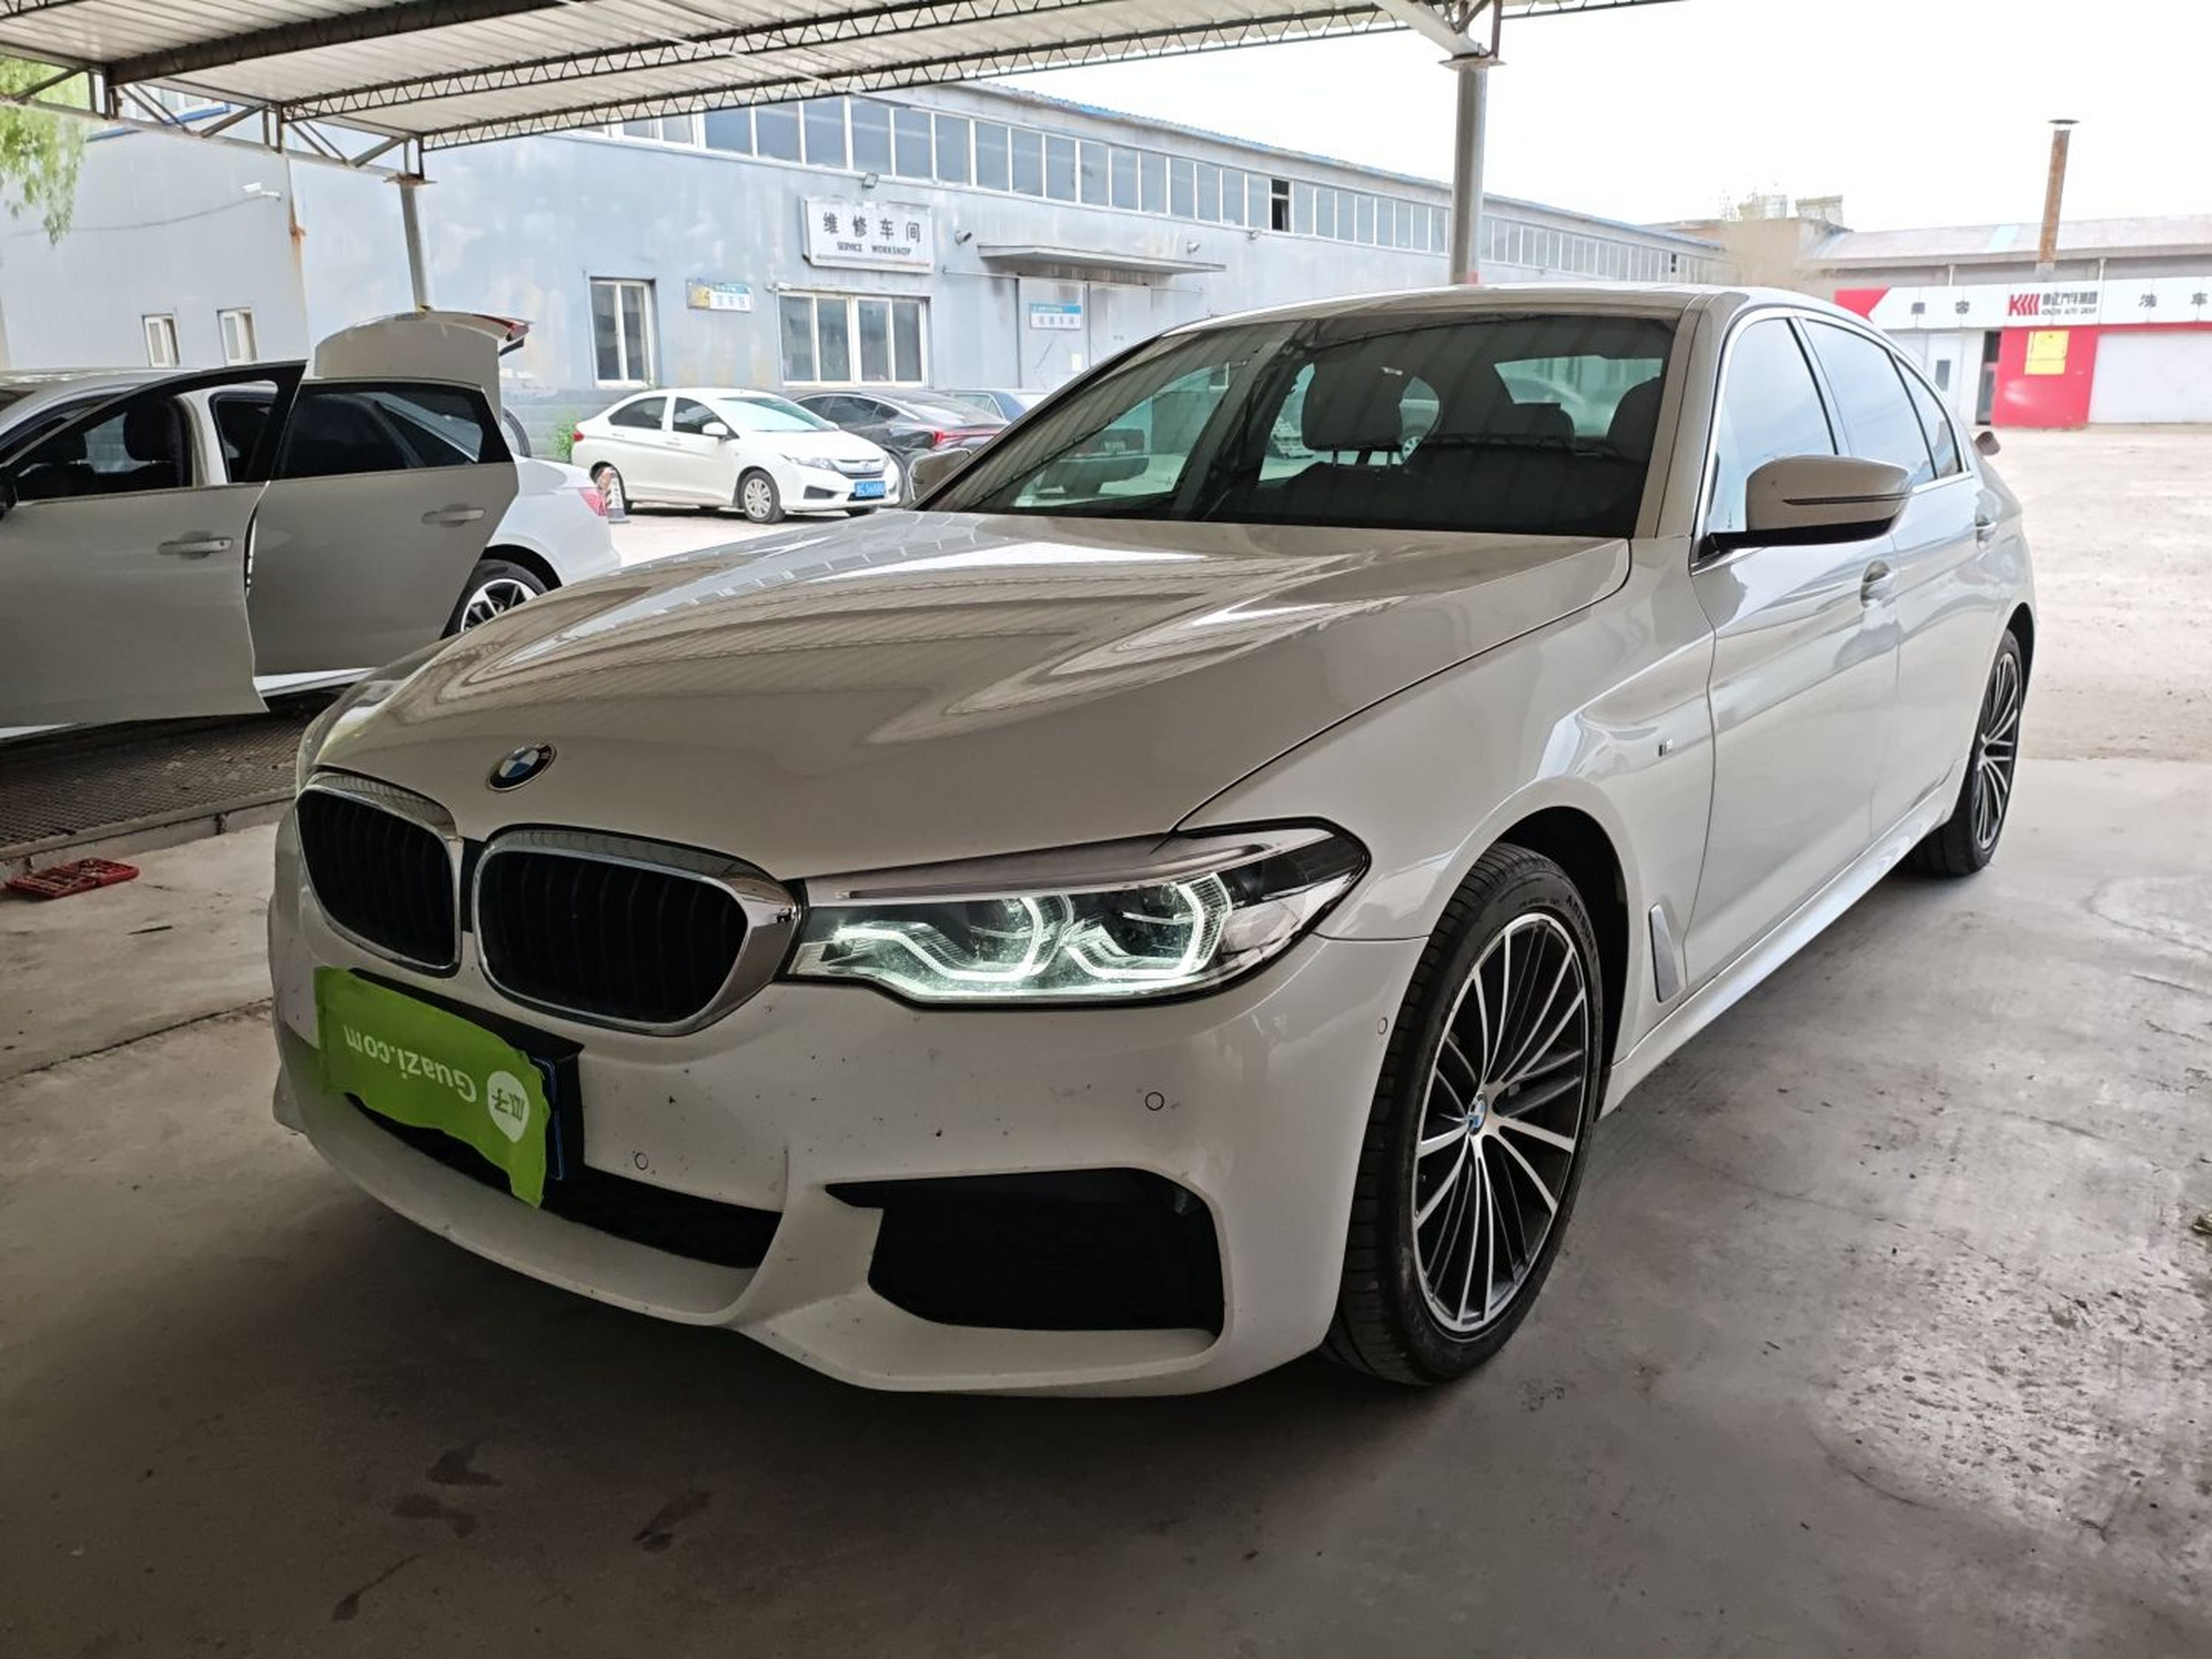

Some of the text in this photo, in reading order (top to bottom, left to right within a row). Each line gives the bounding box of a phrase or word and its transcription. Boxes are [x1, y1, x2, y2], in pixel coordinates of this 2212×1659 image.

[823, 211, 921, 243] 维修车间
[837, 241, 911, 256] SERVICE WORKSHOP
[343, 1025, 477, 1103] Guazi.com
[491, 1088, 524, 1123] 瓜子
